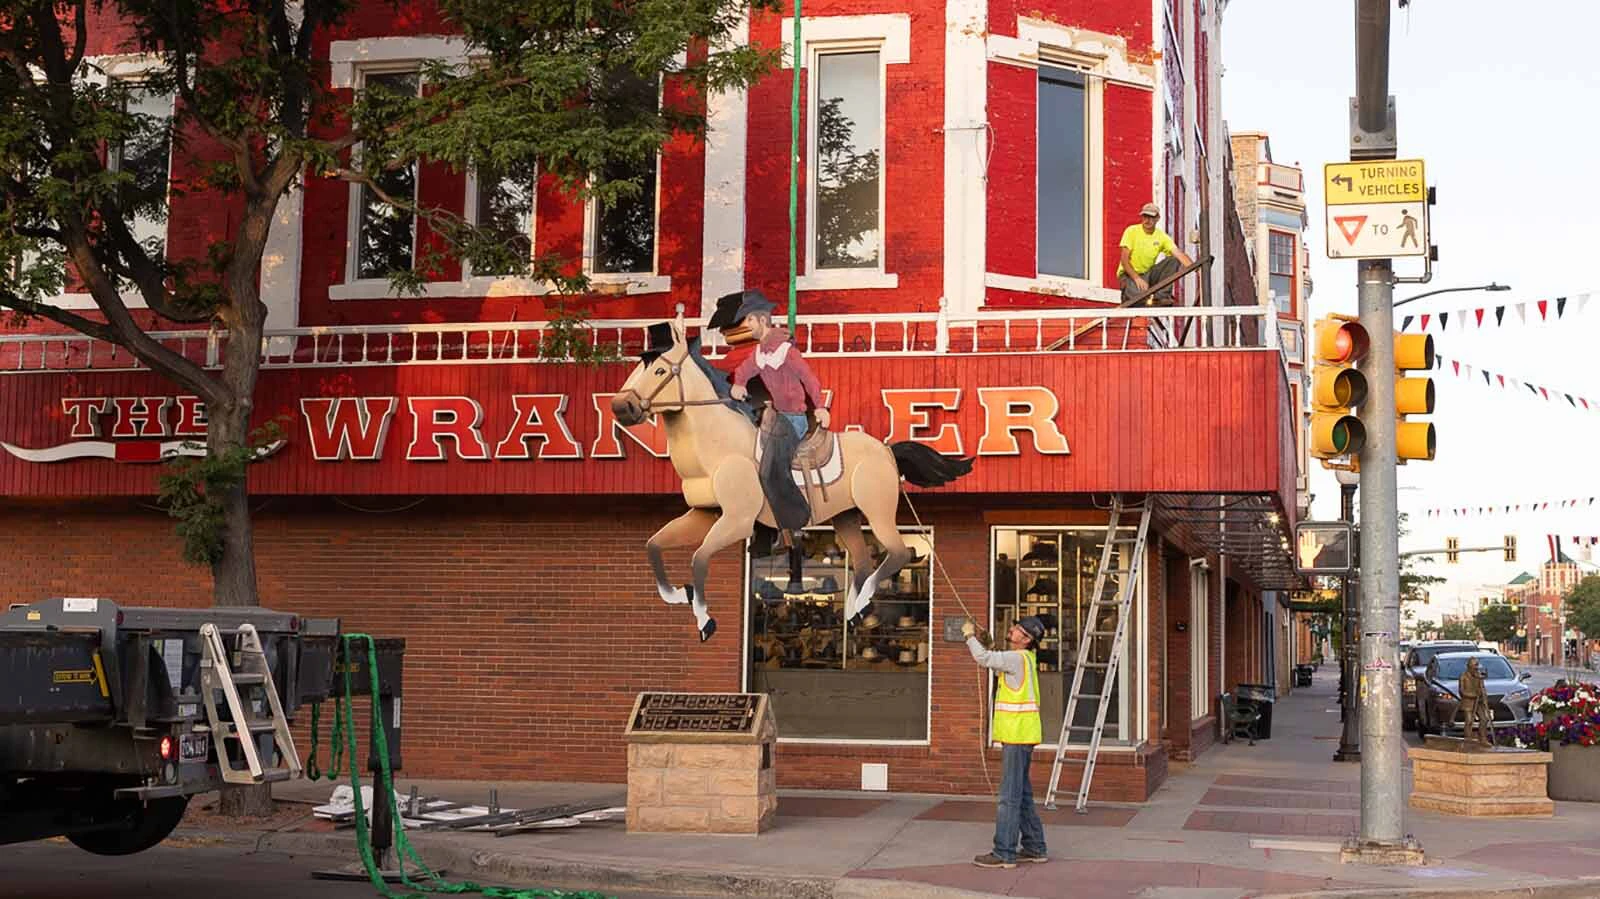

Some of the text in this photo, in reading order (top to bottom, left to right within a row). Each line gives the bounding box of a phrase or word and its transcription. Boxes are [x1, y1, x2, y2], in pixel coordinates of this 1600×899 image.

[1360, 166, 1417, 178] TURNING
[1359, 183, 1420, 196] VEHICLES
[1372, 224, 1389, 235] TO
[61, 385, 1071, 460] THE WRANER
